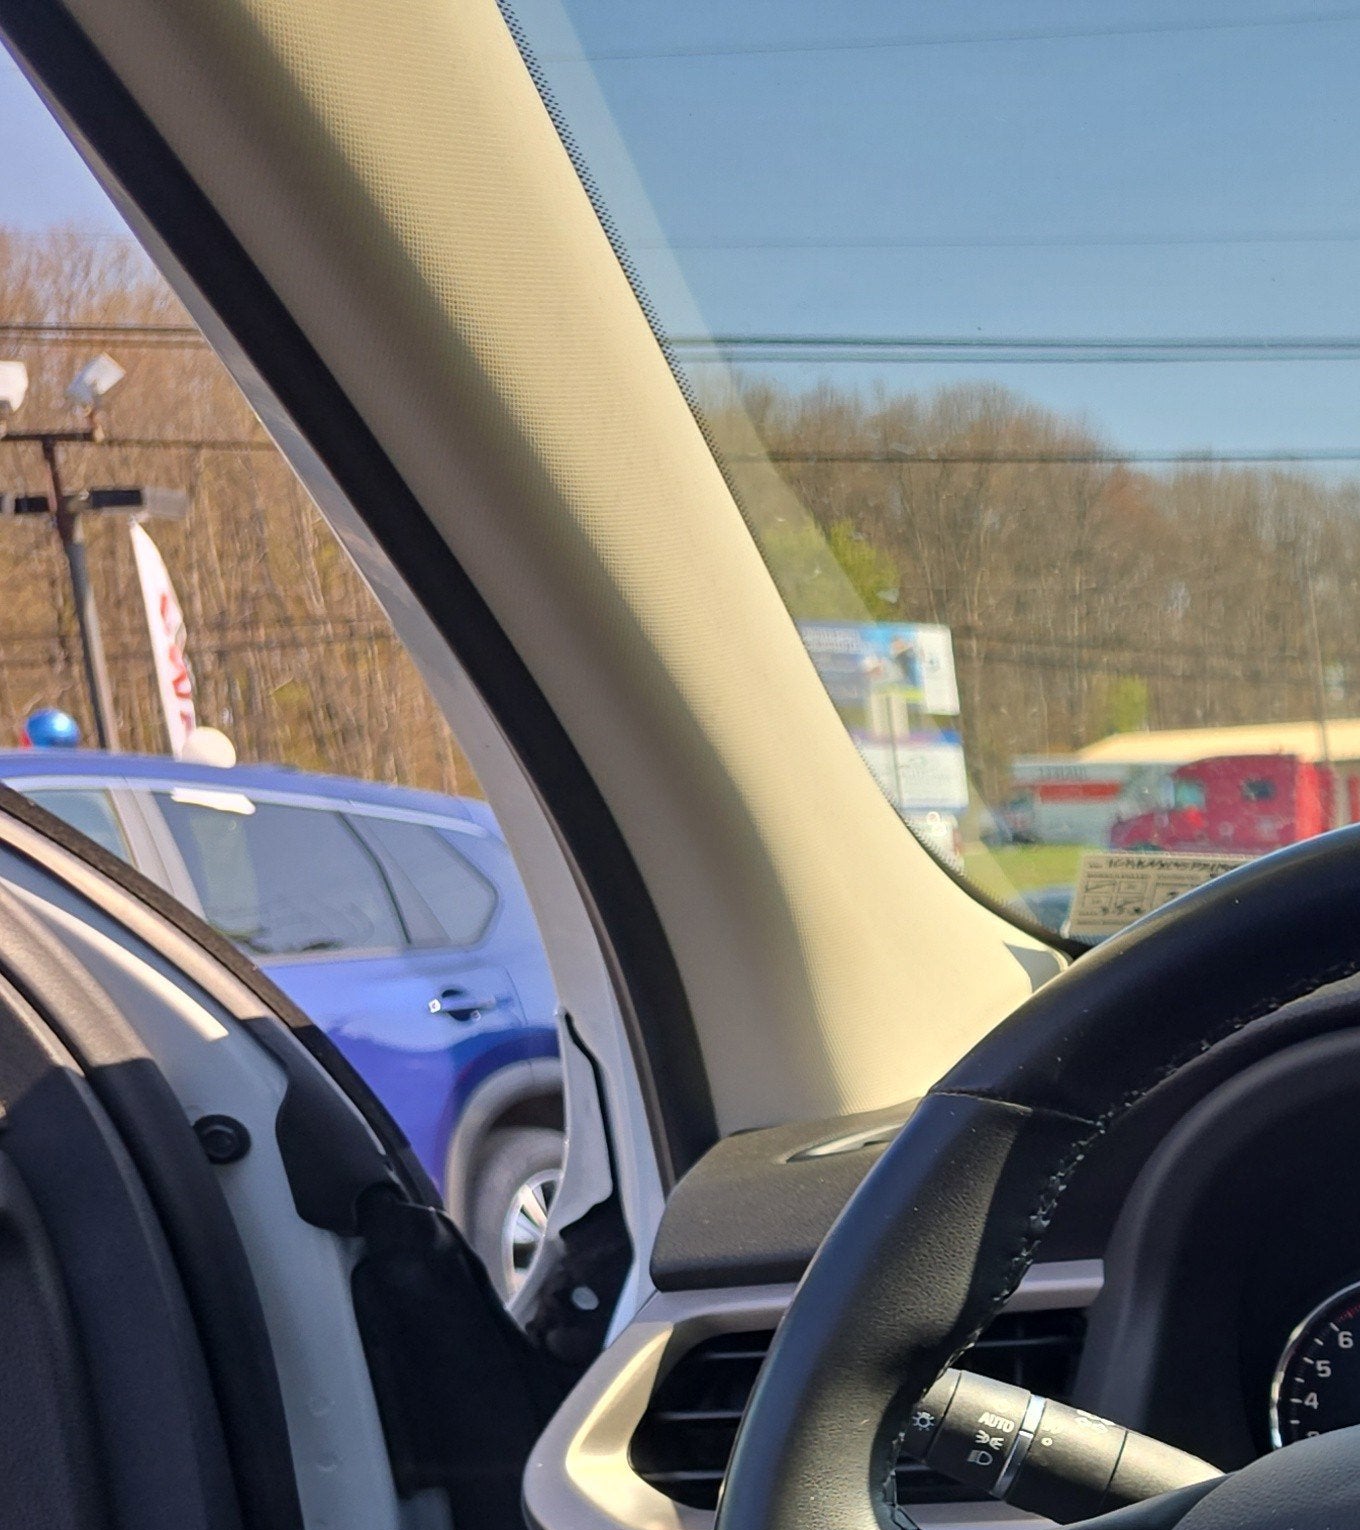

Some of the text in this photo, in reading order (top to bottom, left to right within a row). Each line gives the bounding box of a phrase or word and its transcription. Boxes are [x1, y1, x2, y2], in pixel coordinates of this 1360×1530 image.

[1338, 1331, 1354, 1349] 6
[1315, 1360, 1332, 1378] 5
[1304, 1392, 1319, 1409] 4
[978, 1412, 1015, 1433] AUTO
